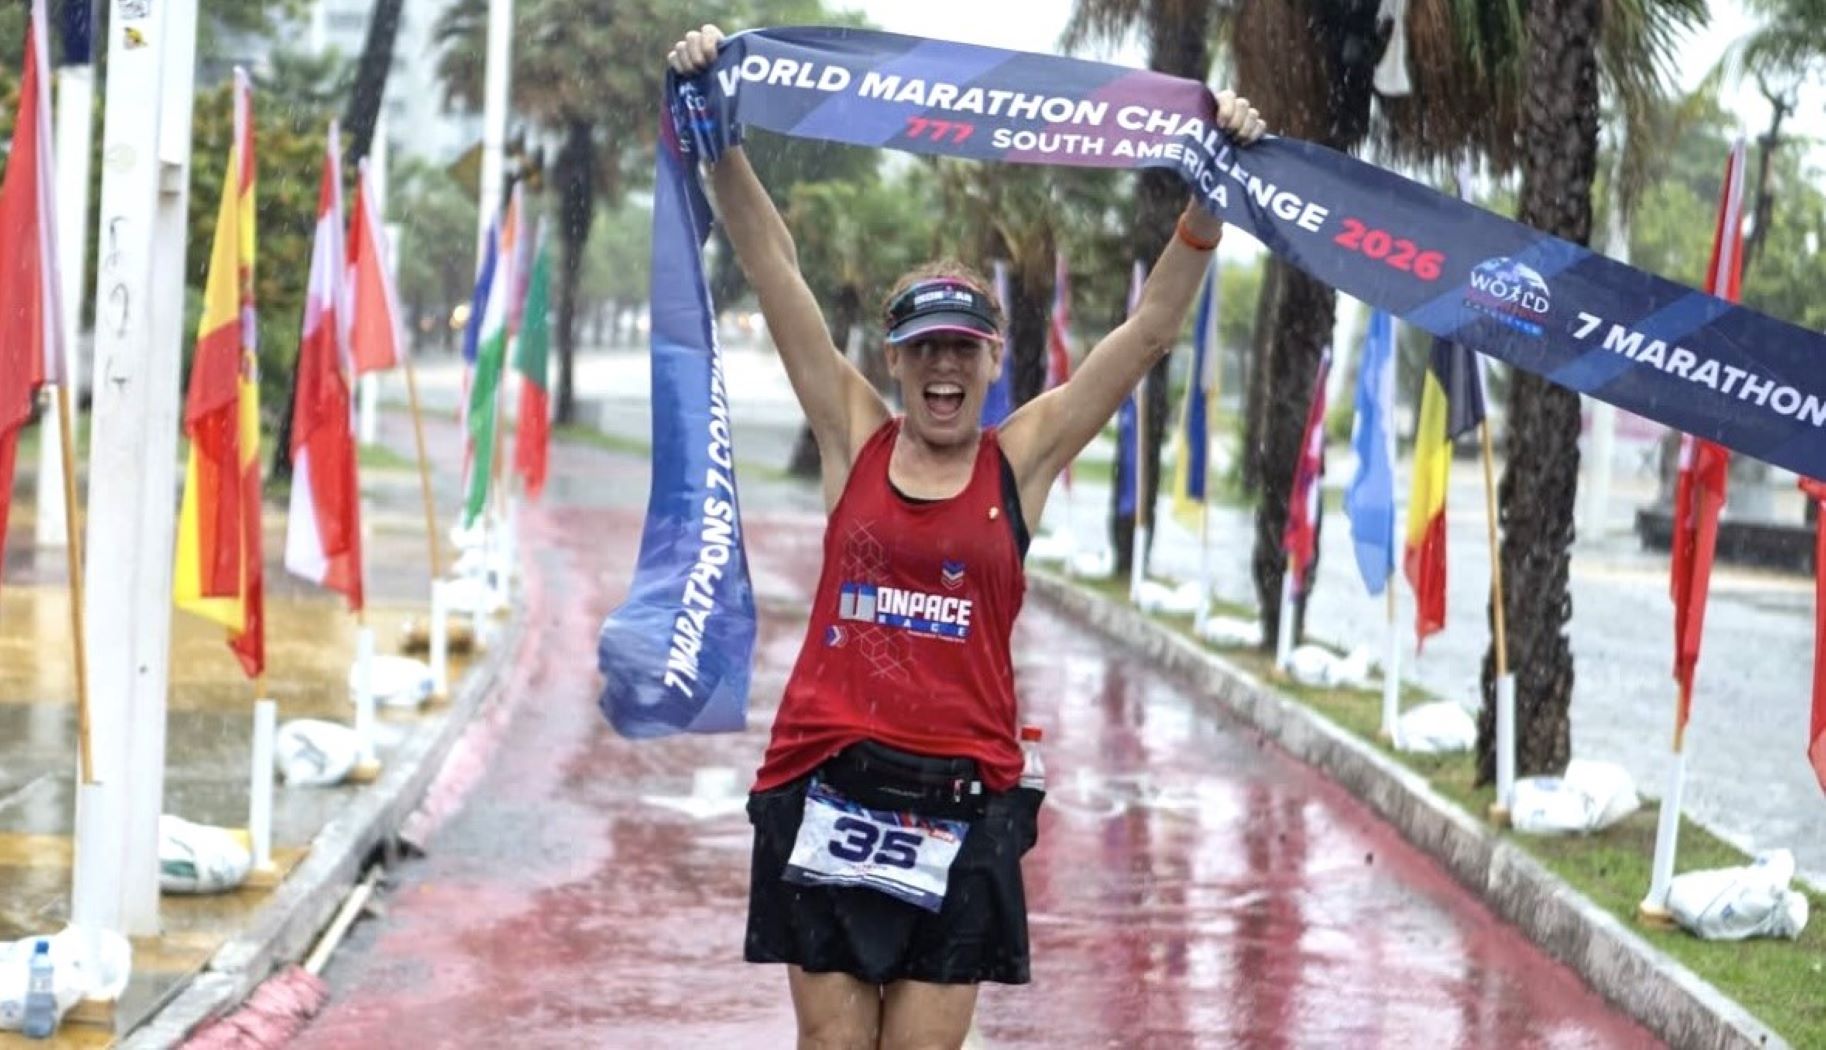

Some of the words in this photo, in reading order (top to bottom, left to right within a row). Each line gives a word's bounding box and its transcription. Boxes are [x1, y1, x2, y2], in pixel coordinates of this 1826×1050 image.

[858, 72, 1108, 126] MARATHON
[1116, 106, 1329, 232] CHALLENGE
[1334, 217, 1446, 281] 2026
[906, 115, 974, 144] 777
[992, 128, 1104, 155] SOUTH
[1112, 139, 1228, 208] AMERICA
[1573, 311, 1602, 340] 7
[706, 468, 734, 496] 7
[667, 497, 733, 681] MARATHONS
[877, 586, 974, 626] ONPACE
[664, 671, 693, 698] 7
[828, 816, 923, 869] 35
